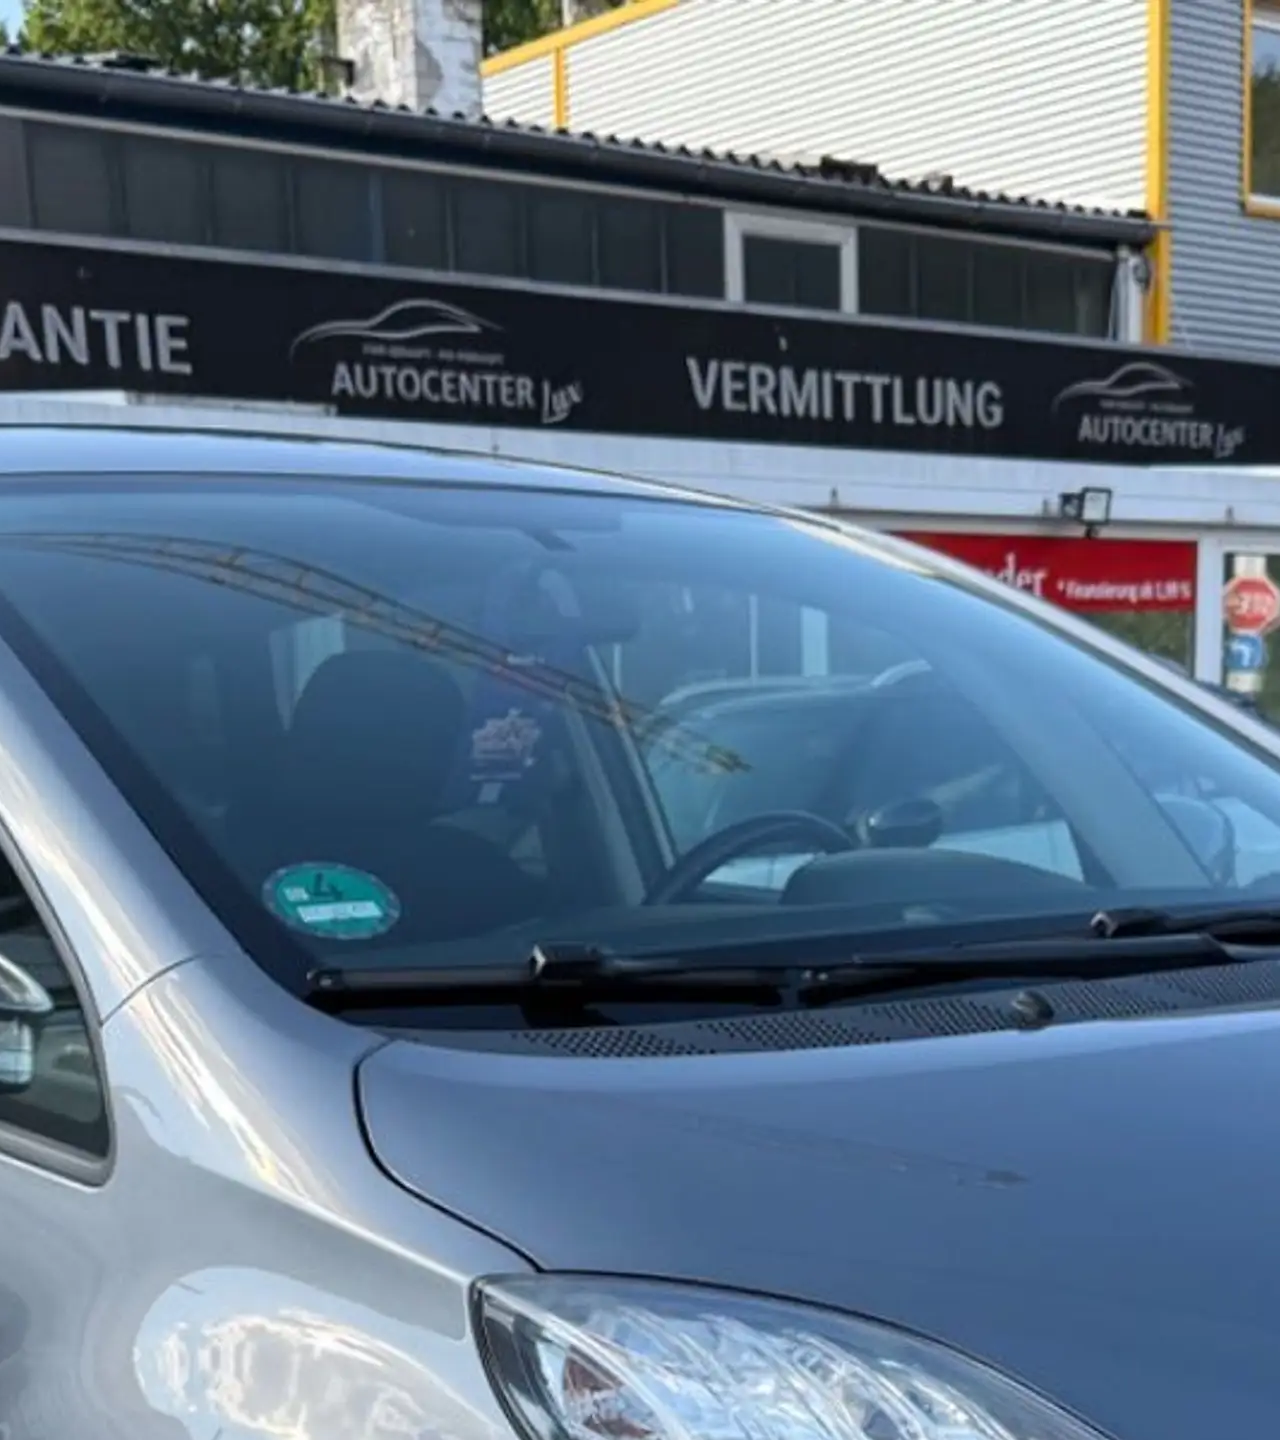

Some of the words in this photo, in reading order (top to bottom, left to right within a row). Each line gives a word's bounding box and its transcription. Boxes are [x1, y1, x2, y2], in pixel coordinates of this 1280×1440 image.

[330, 361, 535, 409] AUTOCENTER
[686, 356, 1004, 428] VERMITTLUNG
[1078, 414, 1212, 449] AUTOCENTER
